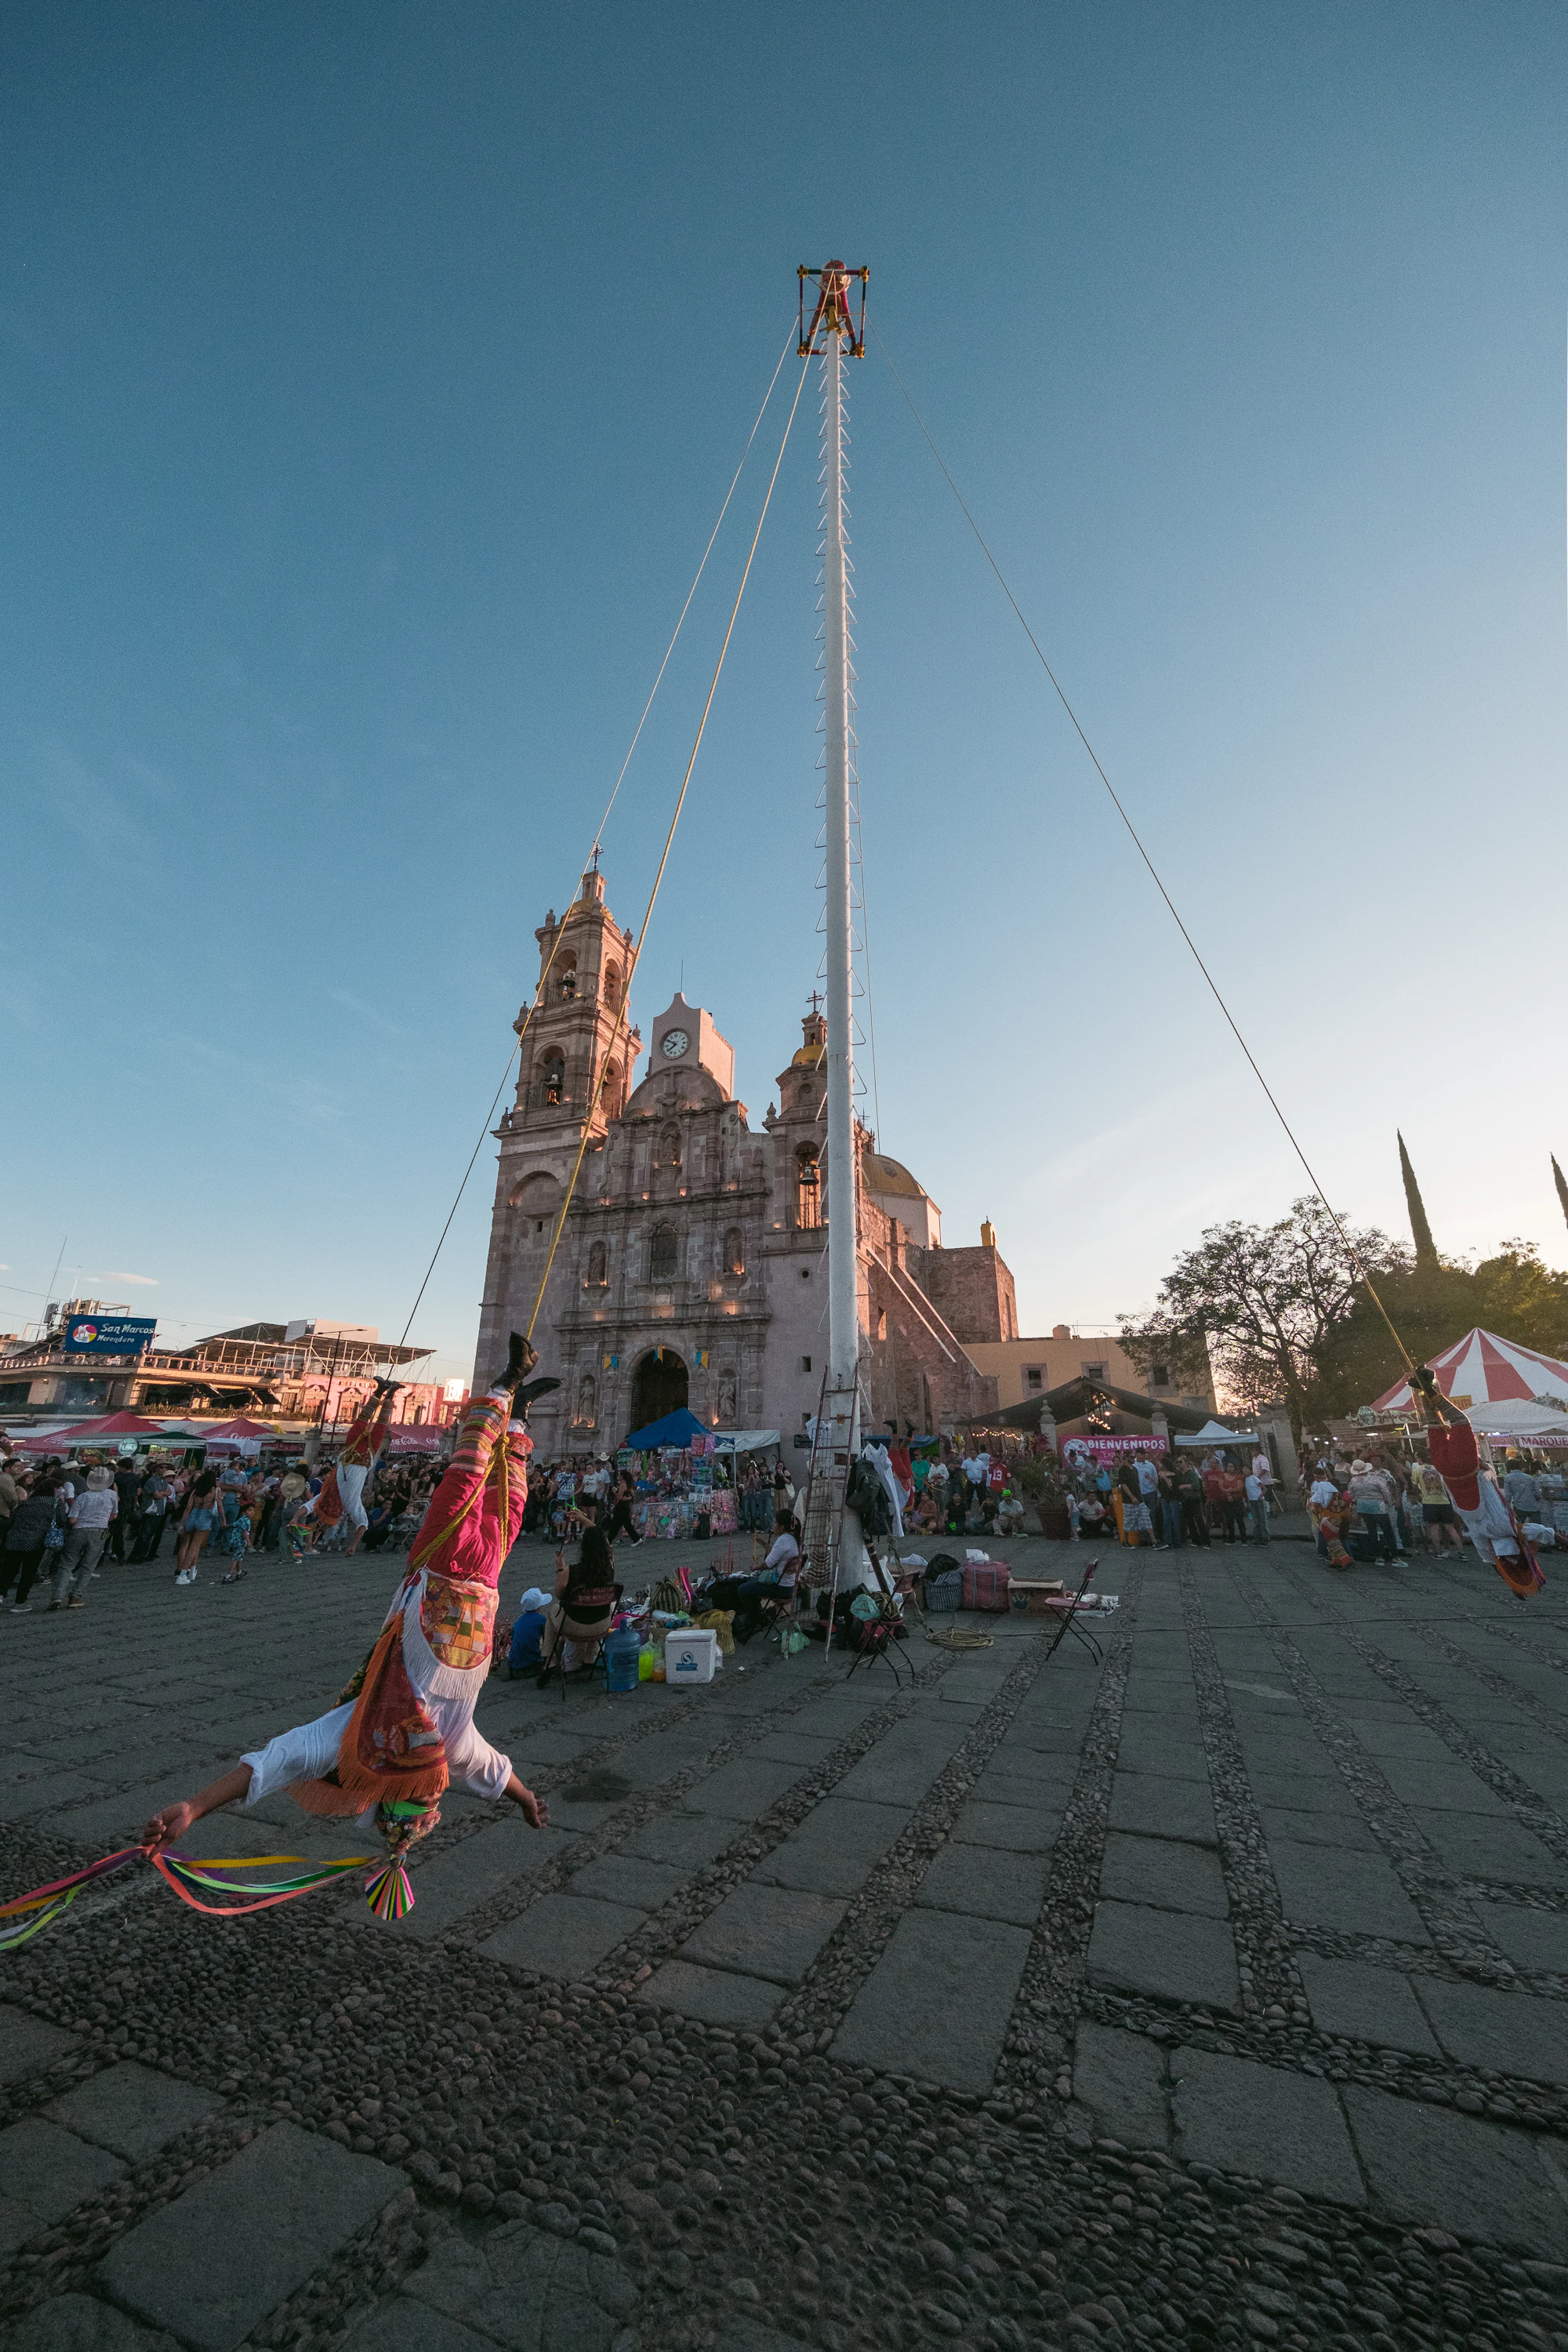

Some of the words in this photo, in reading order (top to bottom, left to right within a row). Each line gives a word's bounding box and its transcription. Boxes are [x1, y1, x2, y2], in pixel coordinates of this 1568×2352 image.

[100, 1323, 121, 1334] San
[122, 1324, 154, 1334] Marcos
[1087, 1439, 1166, 1450] BIENVENIDOS
[992, 1468, 1003, 1482] 13
